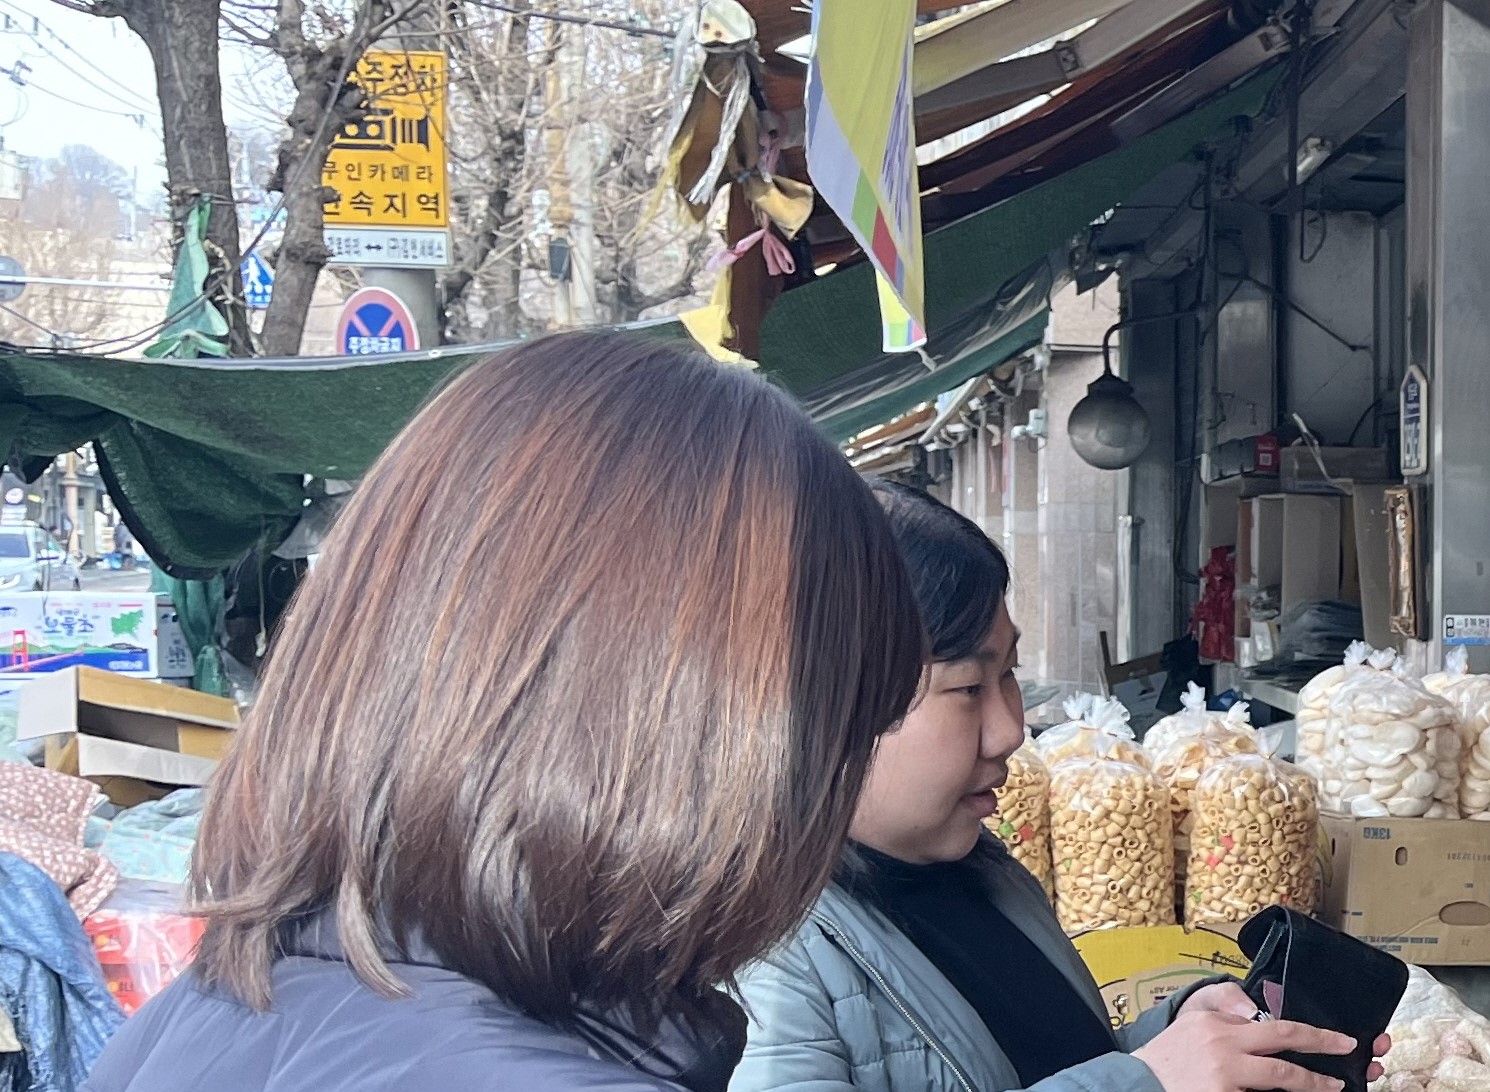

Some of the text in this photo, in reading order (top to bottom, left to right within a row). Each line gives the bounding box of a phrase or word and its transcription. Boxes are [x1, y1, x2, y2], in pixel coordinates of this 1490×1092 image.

[322, 161, 434, 183] 무인카메라
[348, 336, 402, 354] 주정차금지
[1363, 827, 1392, 840] 13KG
